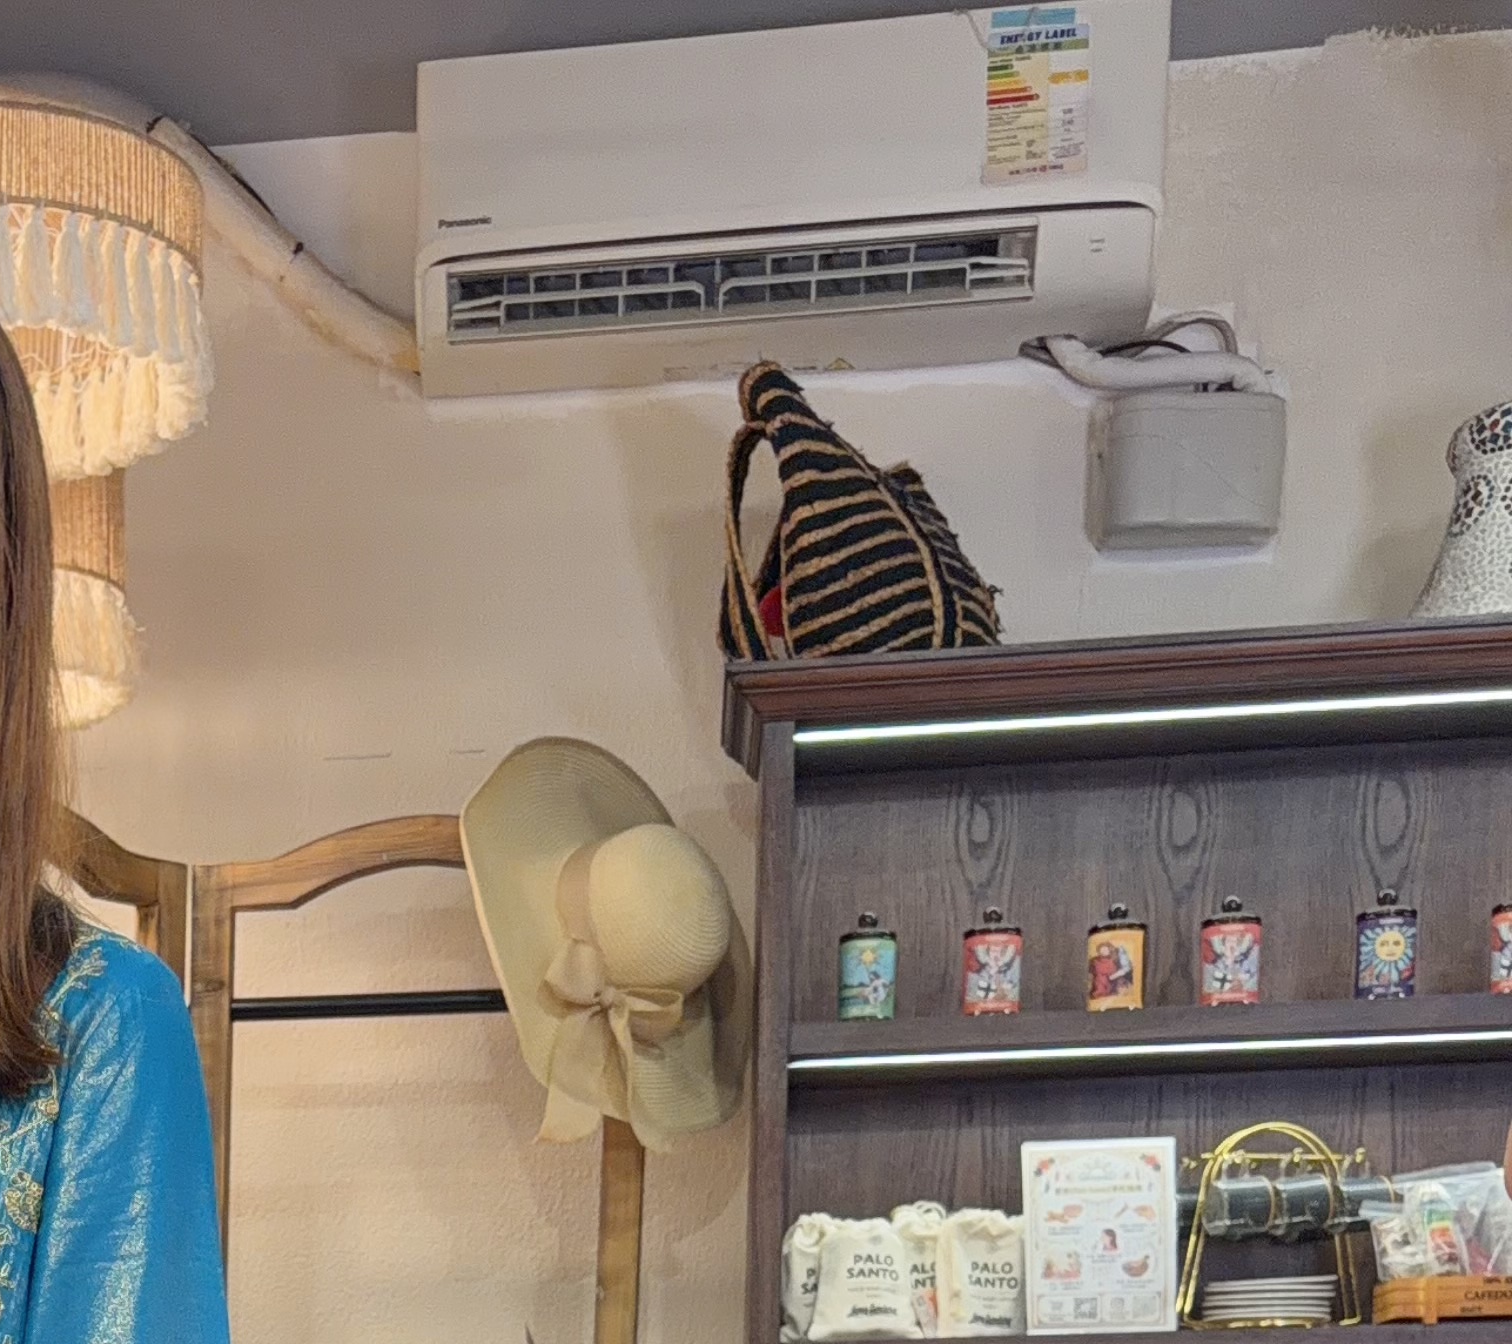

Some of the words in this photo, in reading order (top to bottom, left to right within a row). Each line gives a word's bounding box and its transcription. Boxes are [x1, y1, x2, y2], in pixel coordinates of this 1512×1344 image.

[1000, 30, 1042, 45] ENEGY
[1045, 27, 1077, 40] LABEL
[853, 1253, 894, 1267] PALO
[846, 1267, 899, 1282] SANTO
[971, 1261, 1013, 1275] PALO
